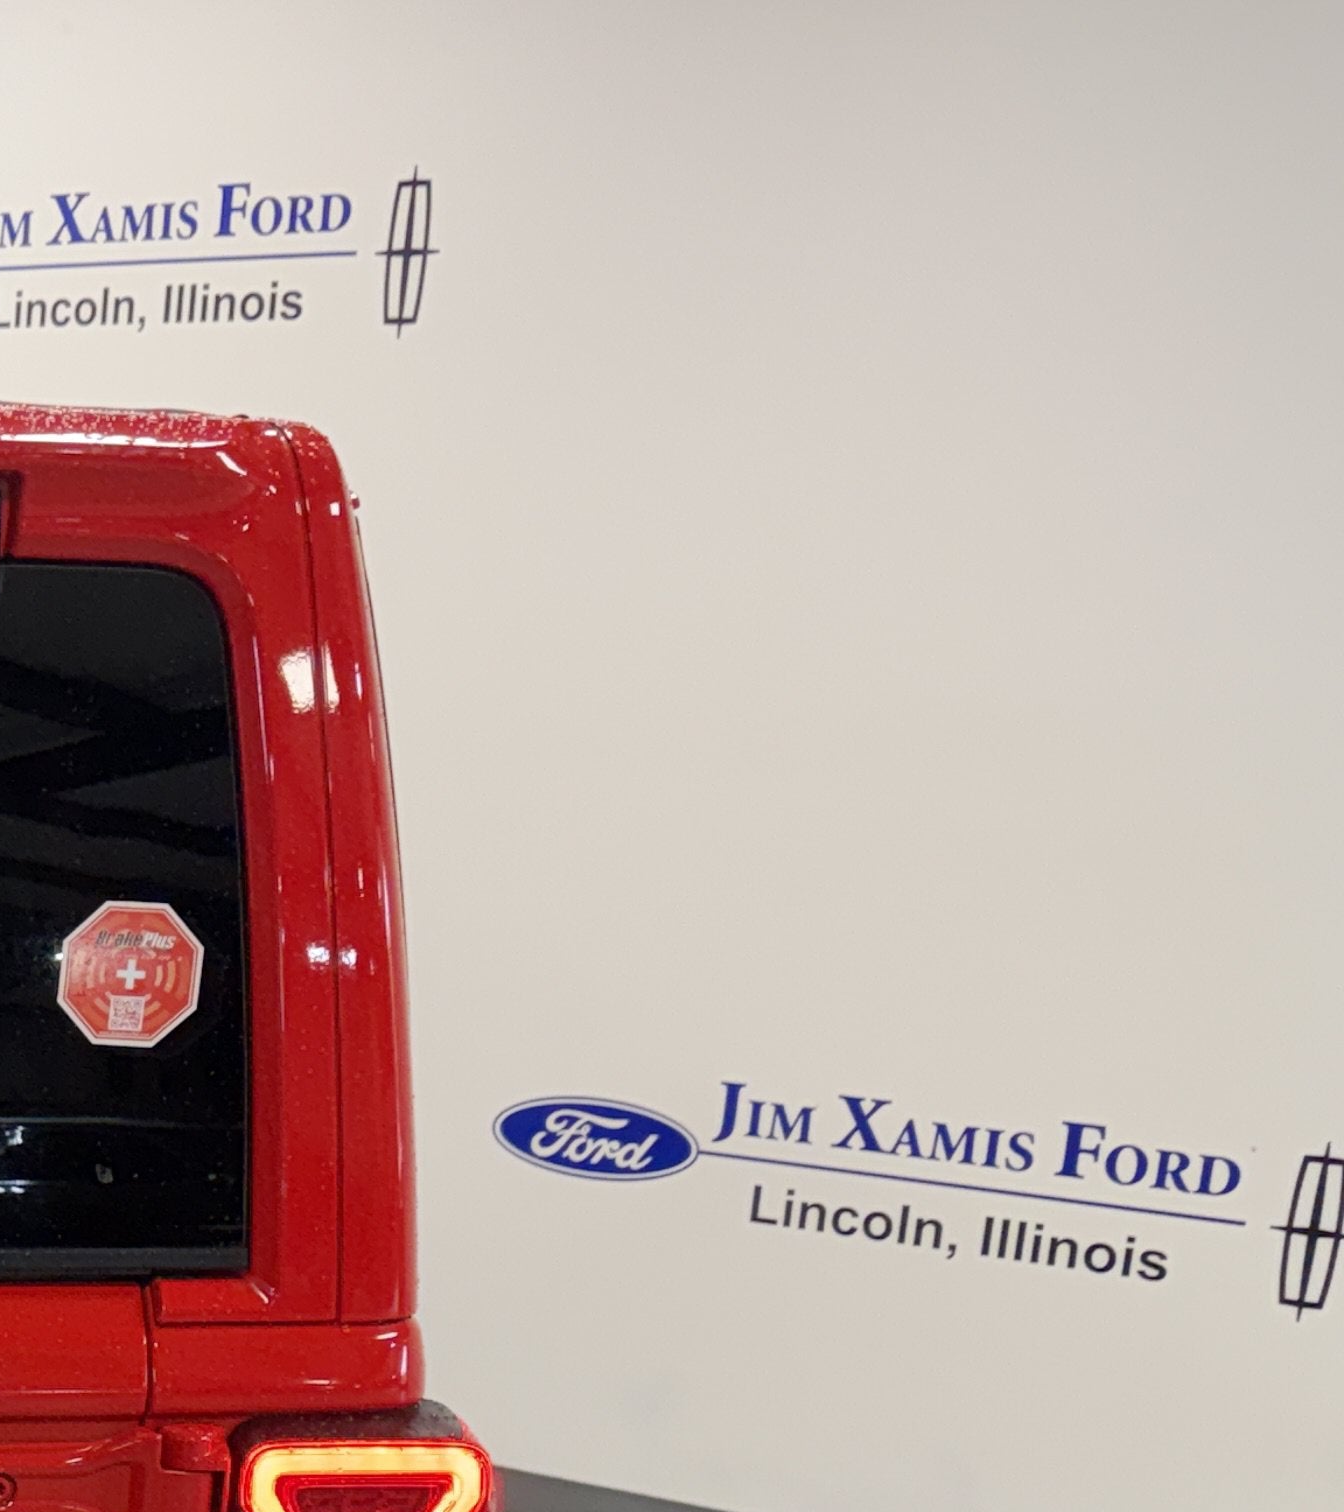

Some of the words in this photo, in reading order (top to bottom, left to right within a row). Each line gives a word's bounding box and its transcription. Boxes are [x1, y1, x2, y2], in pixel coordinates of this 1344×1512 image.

[163, 281, 303, 323] Illinois
[530, 1109, 659, 1171] Ford
[749, 1184, 959, 1260] Lincoln,
[980, 1215, 1169, 1282] Illinois
